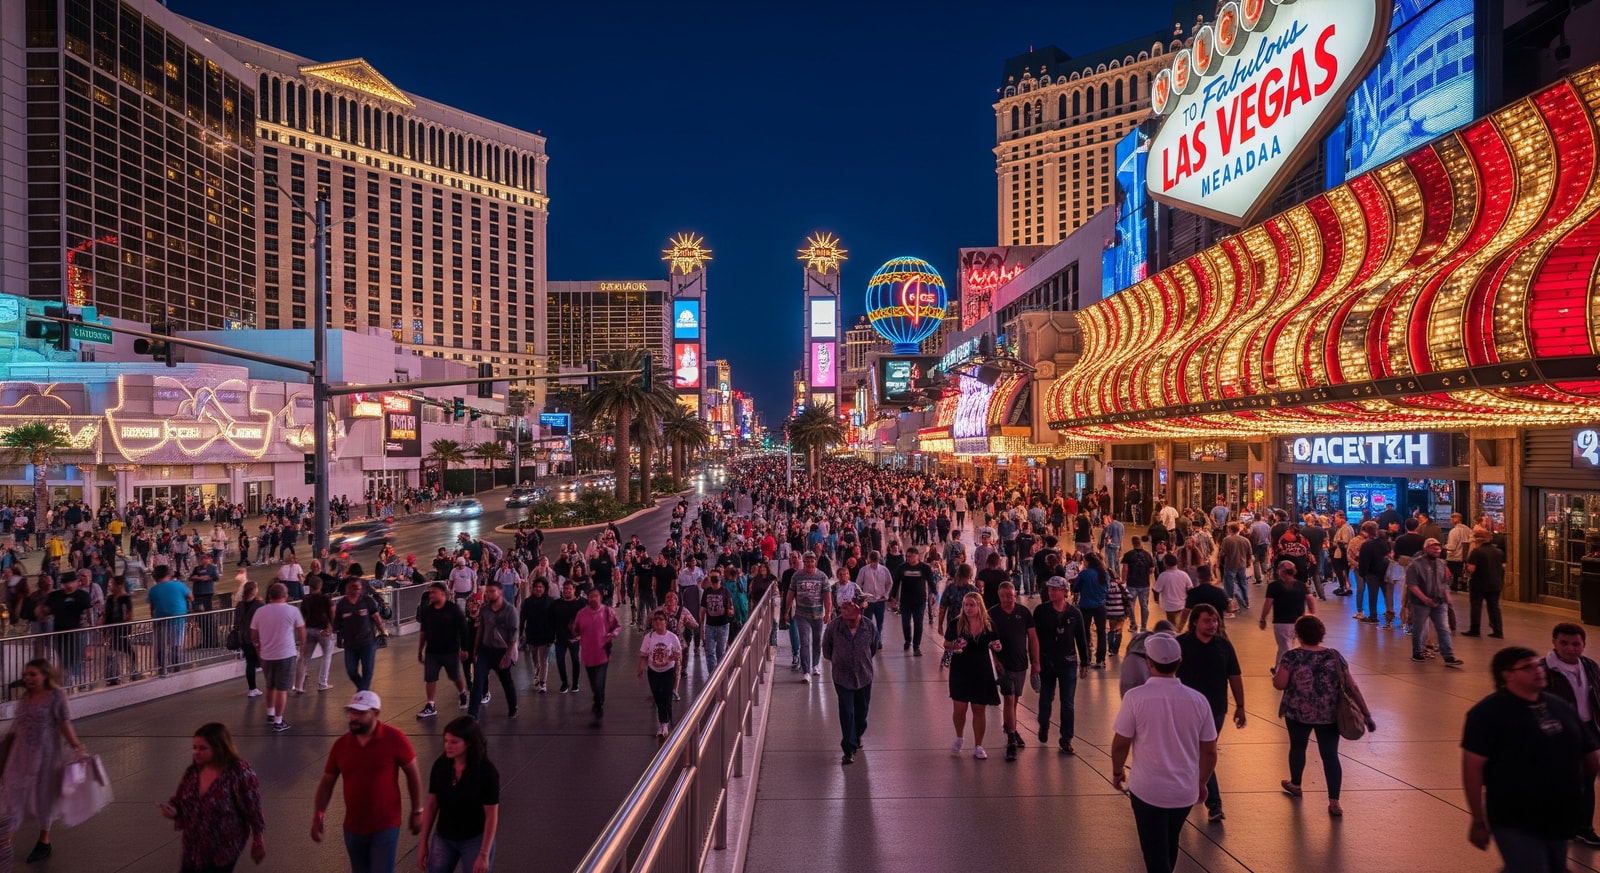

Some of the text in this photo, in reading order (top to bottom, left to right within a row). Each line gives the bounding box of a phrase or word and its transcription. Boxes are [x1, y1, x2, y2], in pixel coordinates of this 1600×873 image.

[1163, 24, 1338, 192] LAS VEGAS
[1183, 20, 1308, 126] TO Fabulous
[1201, 135, 1281, 198] MEAADAA
